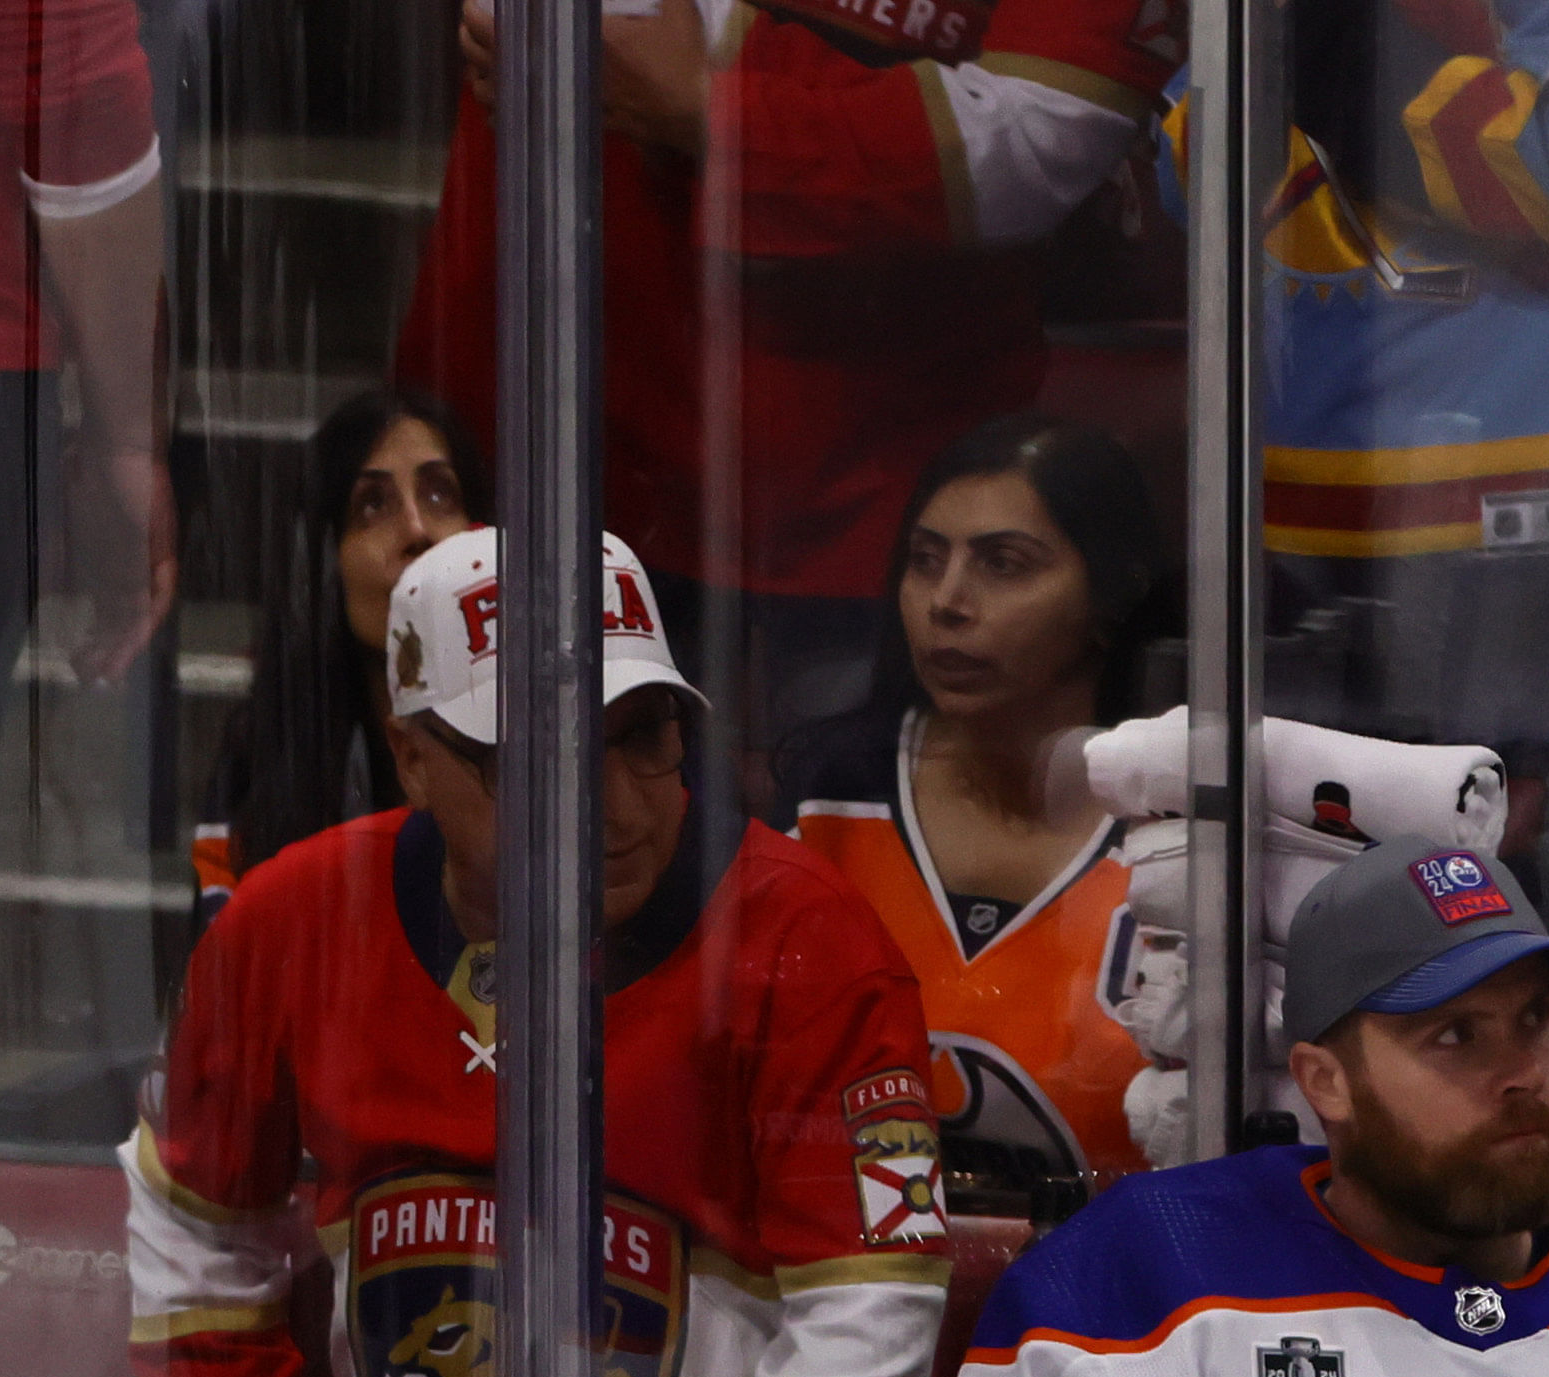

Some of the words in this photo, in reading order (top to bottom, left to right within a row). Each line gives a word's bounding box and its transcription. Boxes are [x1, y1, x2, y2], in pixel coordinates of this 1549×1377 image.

[1418, 860, 1443, 881] 20
[1428, 876, 1454, 898] 24
[371, 1197, 651, 1274] PANTHRS
